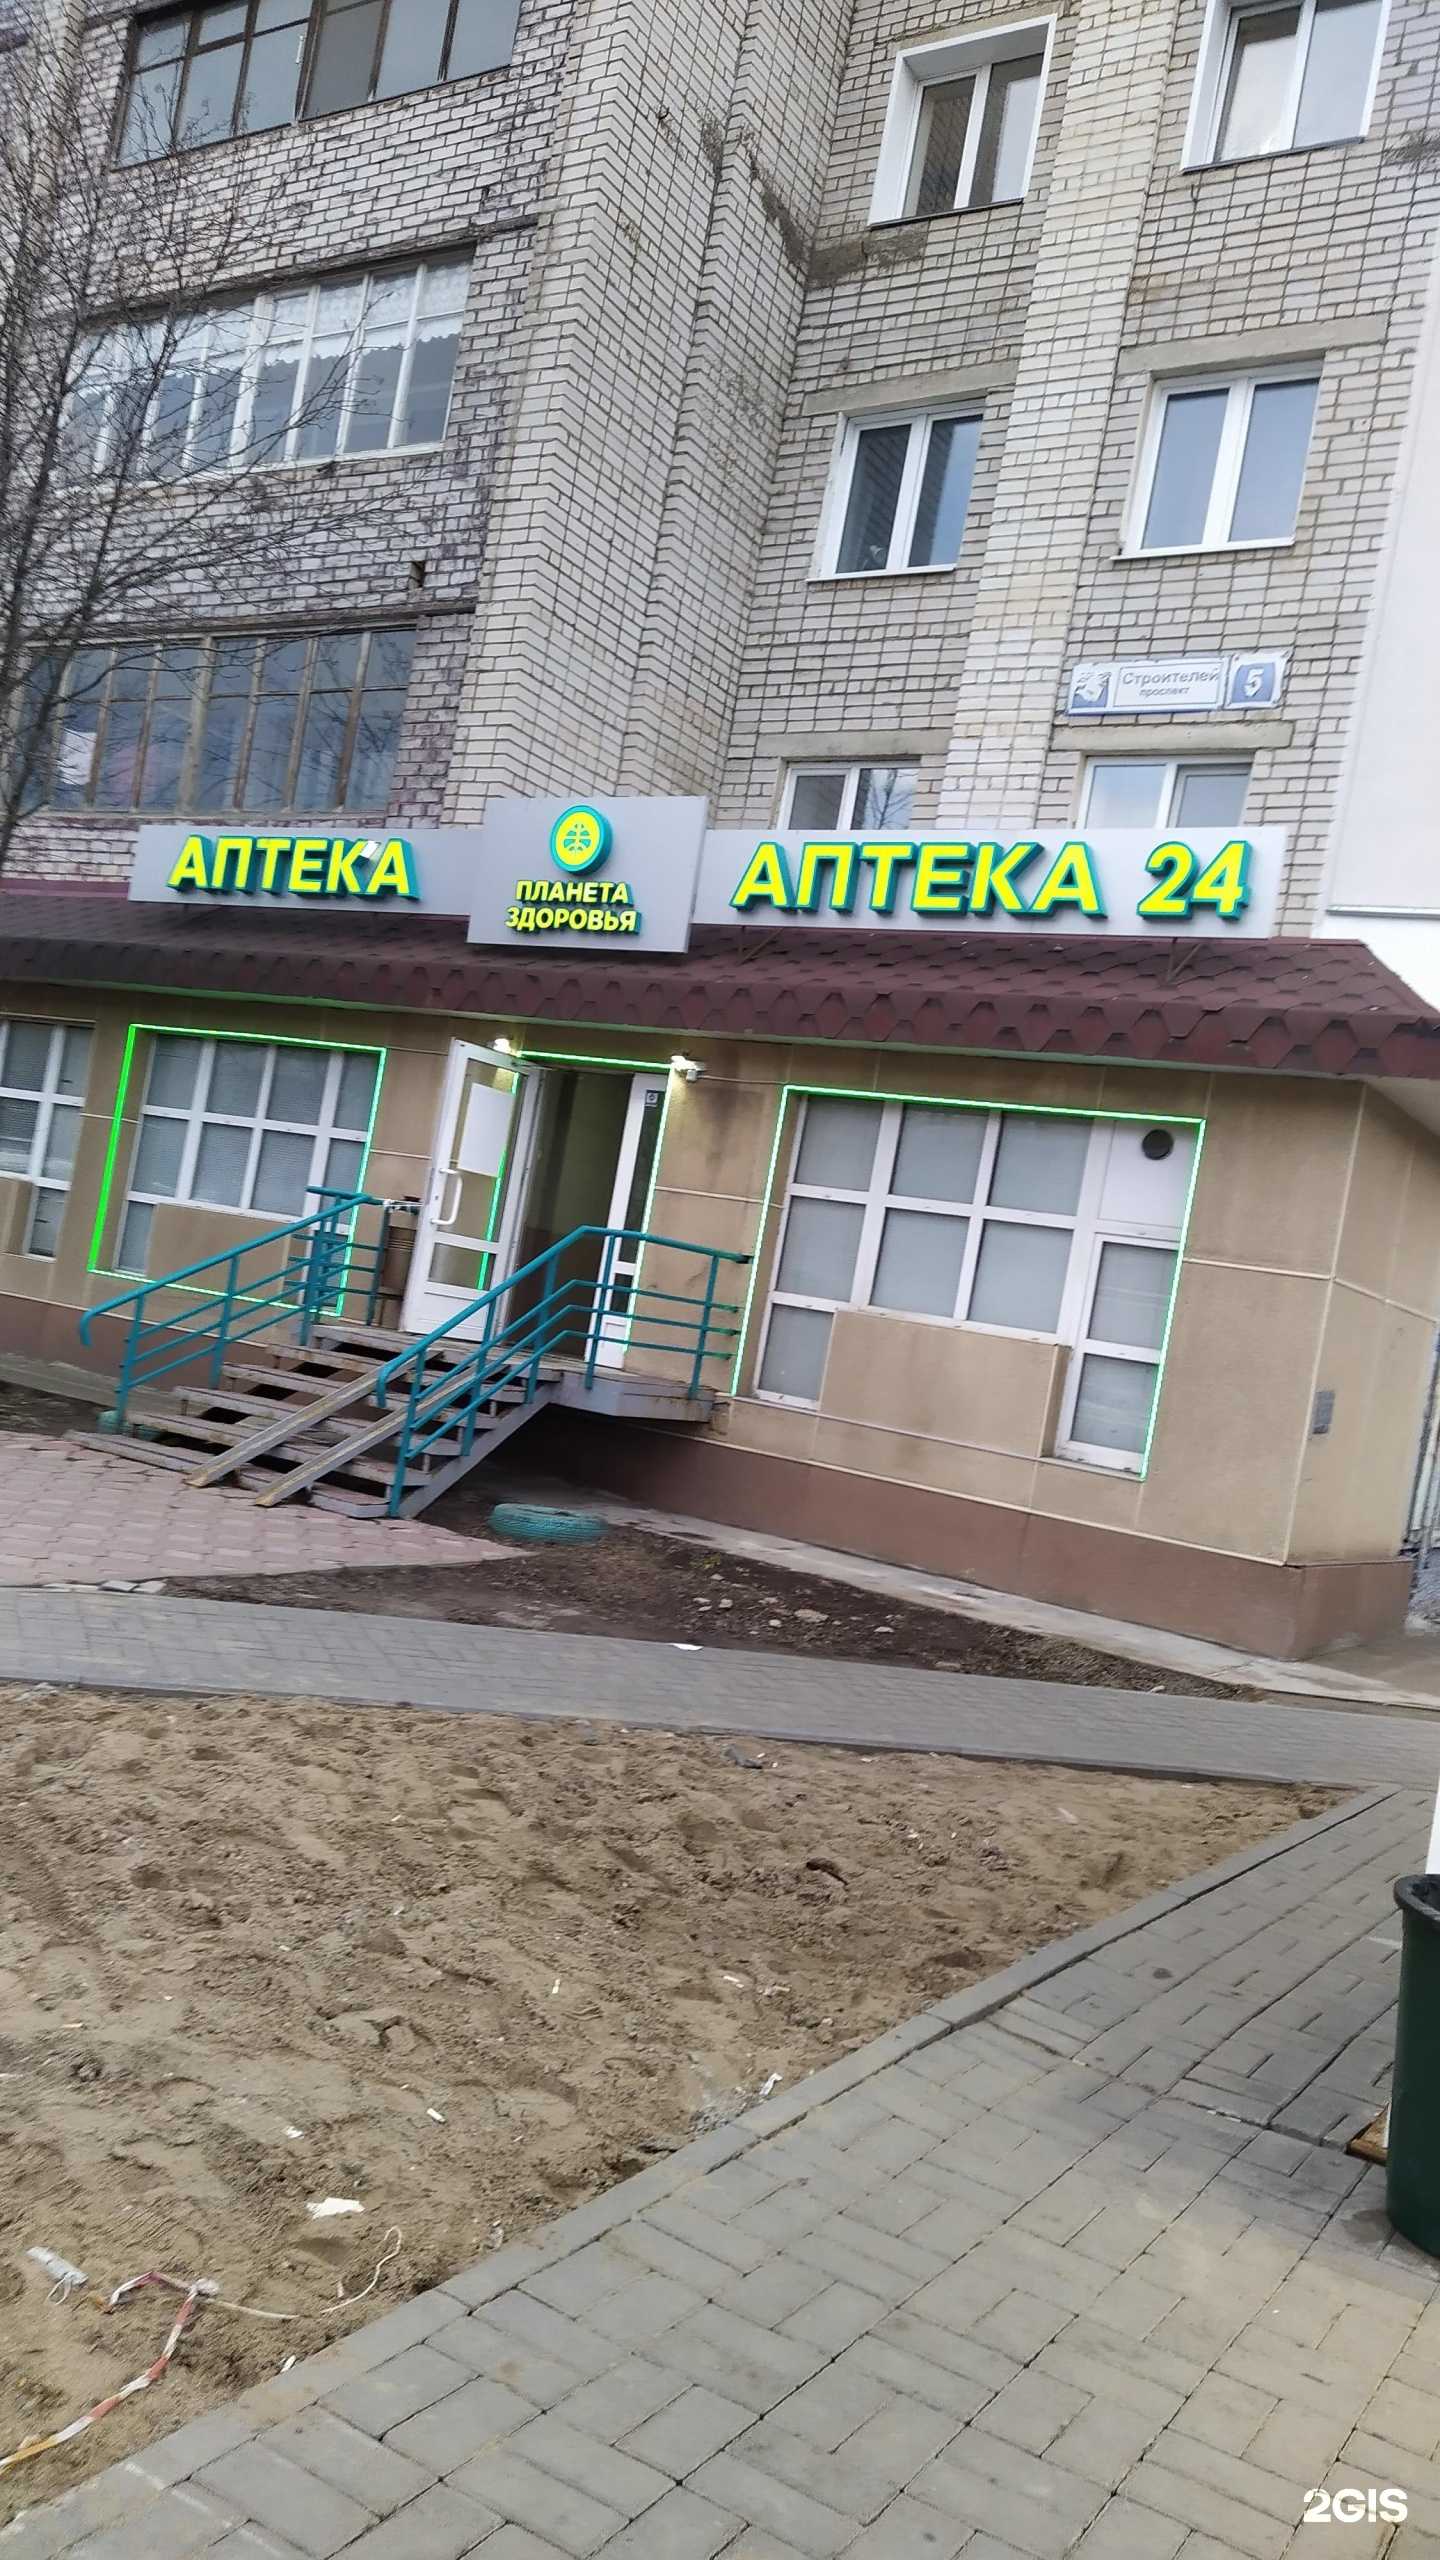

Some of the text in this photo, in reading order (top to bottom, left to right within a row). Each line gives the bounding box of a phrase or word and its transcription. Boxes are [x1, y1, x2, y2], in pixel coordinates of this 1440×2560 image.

[1121, 667, 1220, 686] Строителей
[1243, 668, 1263, 698] 5
[1138, 686, 1189, 698] проспект
[167, 834, 418, 900] АПТЕКА
[730, 840, 1251, 920] АПТЕКА 24
[514, 880, 634, 905] ПЛАНЕТА
[504, 907, 641, 935] ЗДОРОВЬЯ
